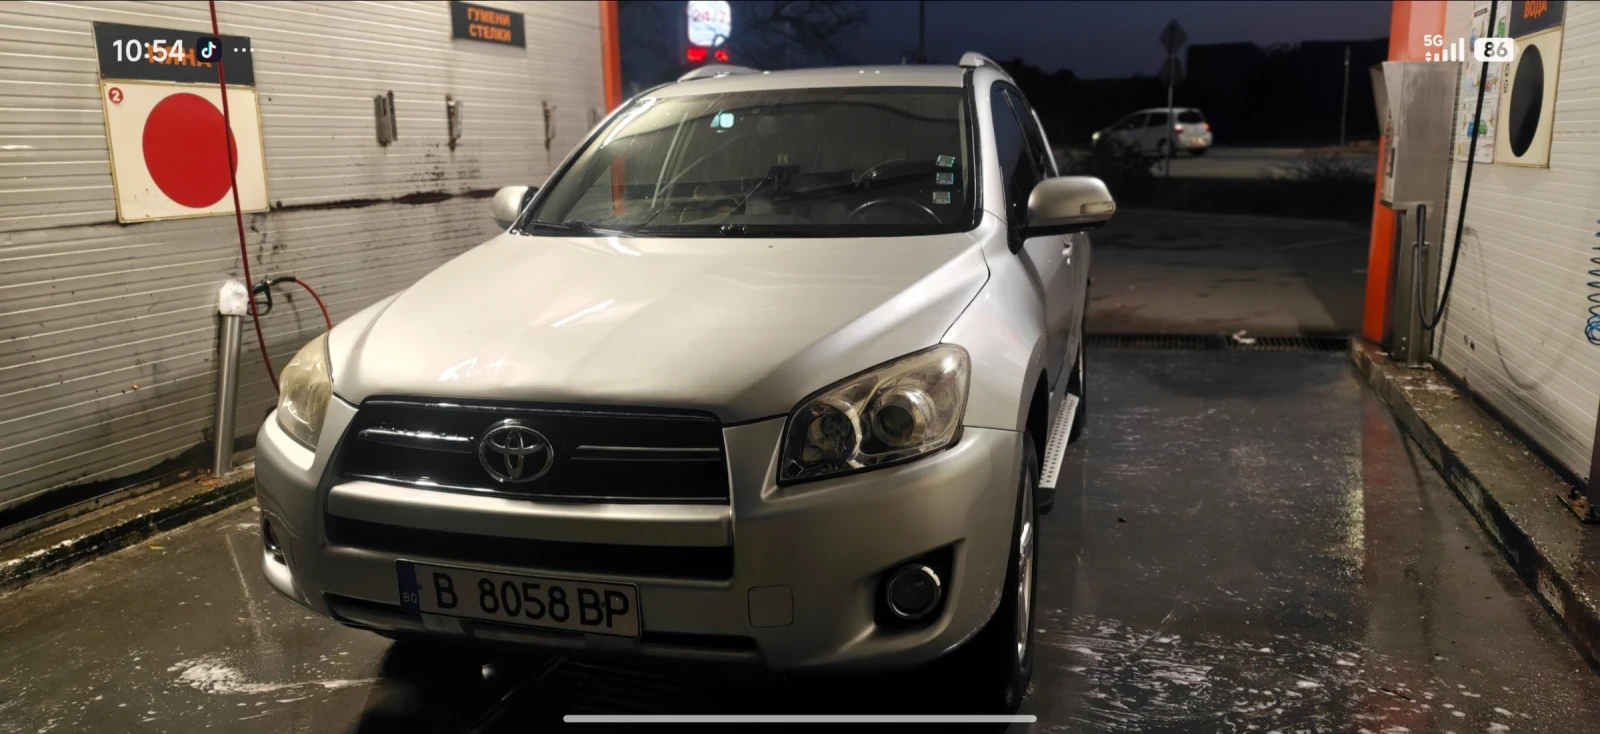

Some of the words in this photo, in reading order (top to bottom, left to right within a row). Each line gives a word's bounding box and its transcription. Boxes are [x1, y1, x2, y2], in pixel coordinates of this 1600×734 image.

[467, 7, 510, 26] ГУМЕНИ
[692, 9, 726, 23] 24/7
[1524, 1, 1547, 18] ВОДА
[469, 24, 512, 42] СТЕЛКИ
[111, 90, 121, 102] 2
[402, 592, 418, 604] BG
[433, 572, 458, 609] B
[478, 578, 570, 622] 8058
[577, 587, 629, 628] BP
